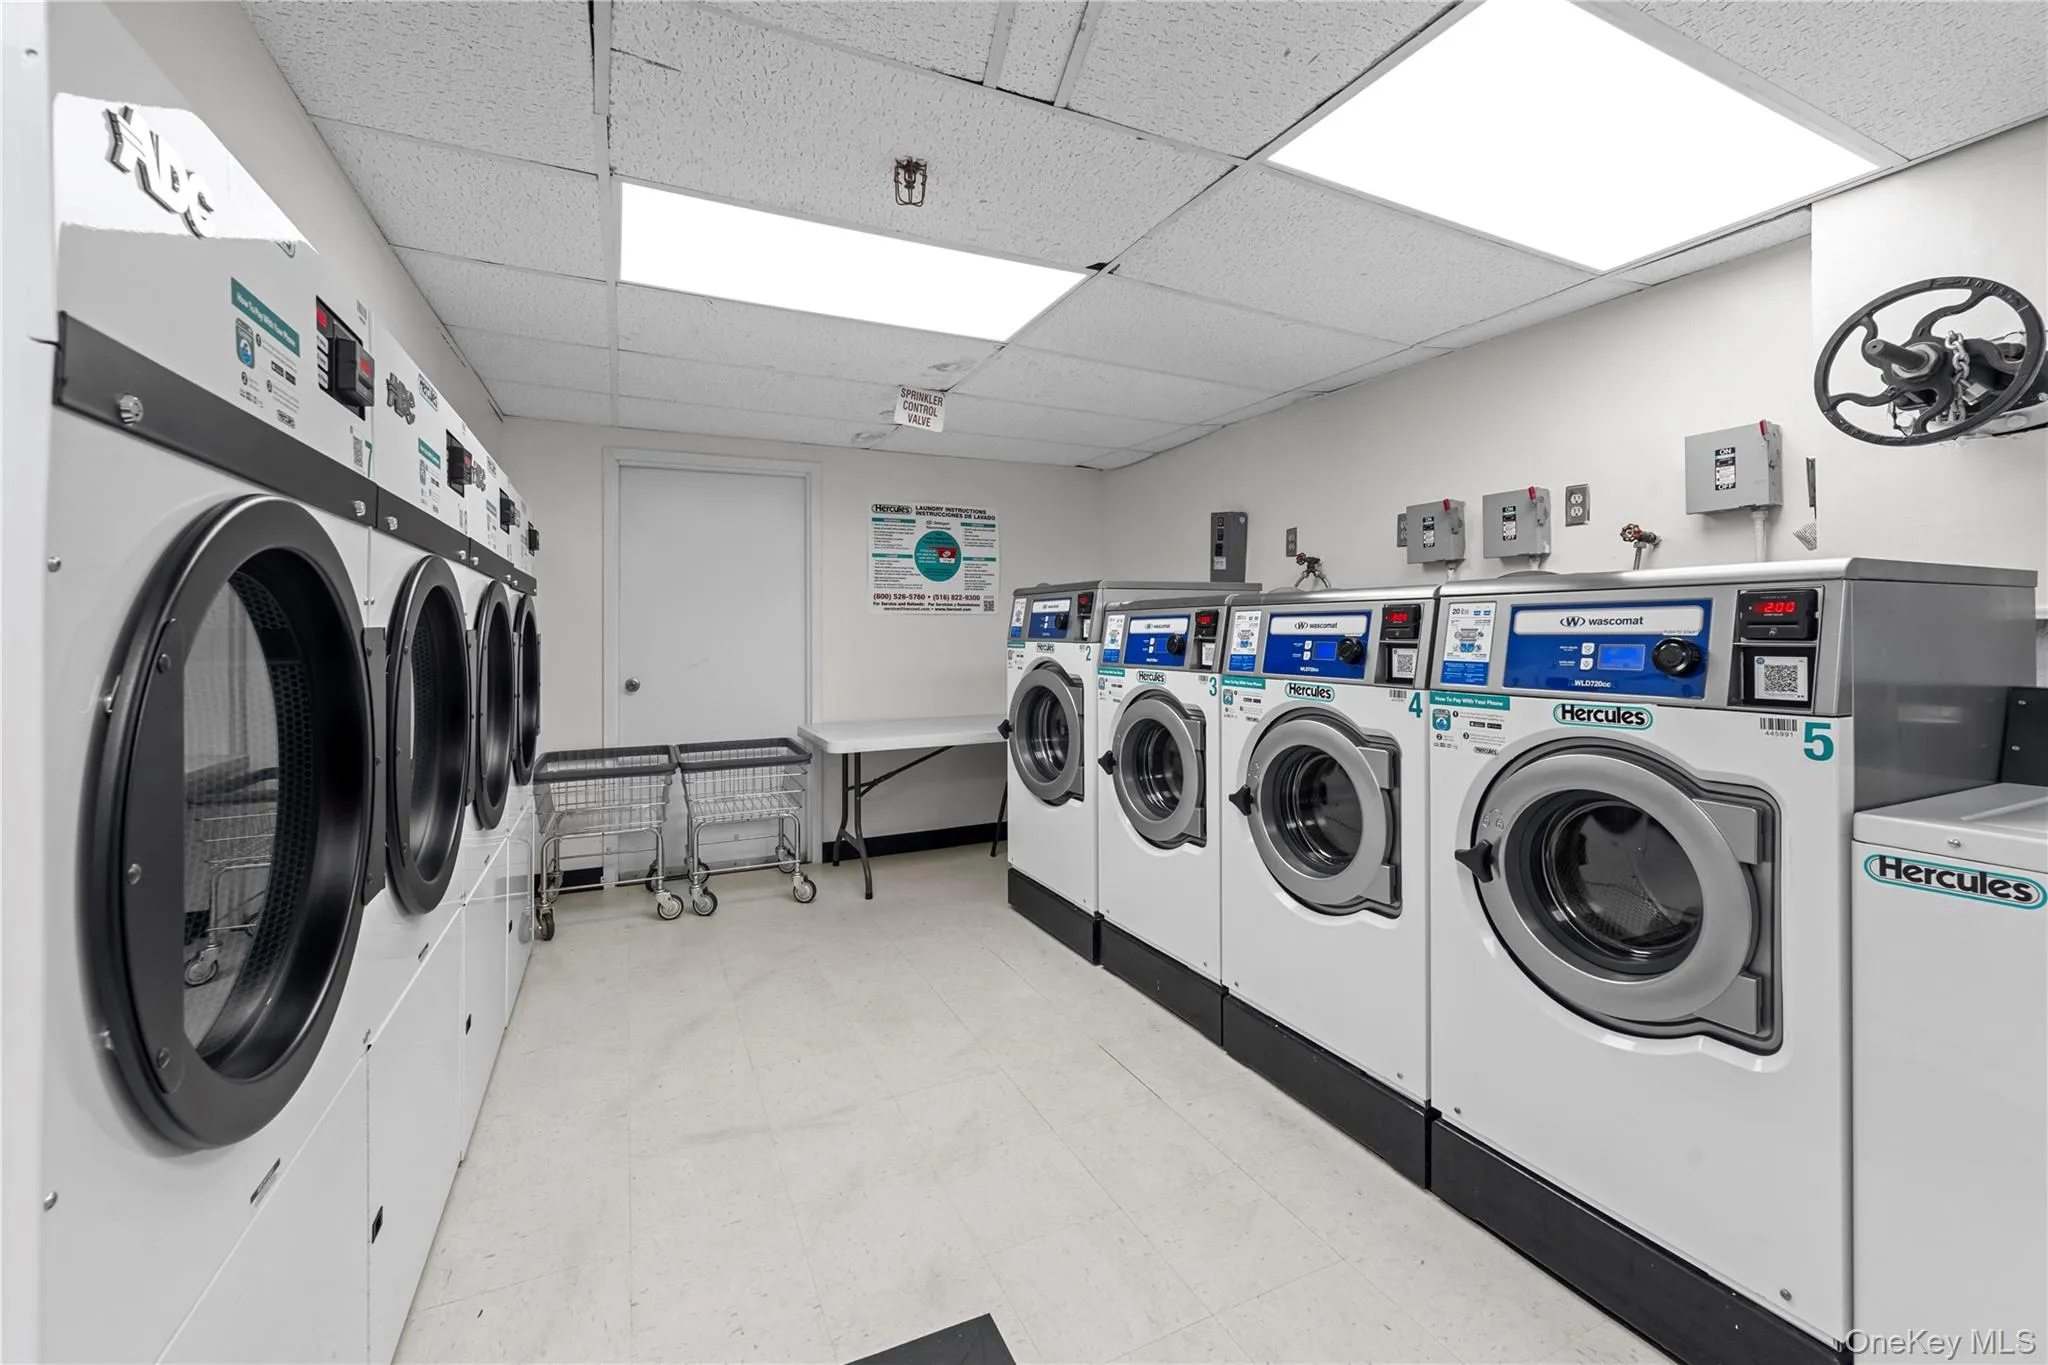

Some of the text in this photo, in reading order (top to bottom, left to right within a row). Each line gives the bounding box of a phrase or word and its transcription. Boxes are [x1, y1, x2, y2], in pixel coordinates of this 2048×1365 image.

[901, 388, 943, 406] SPRINKLER
[903, 400, 938, 418] CONTROL
[908, 414, 931, 427] VALVE
[876, 504, 910, 514] Hercules
[1588, 616, 1644, 626] wascomat
[1086, 646, 1091, 661] 2
[1138, 670, 1164, 682] Hercules
[1210, 677, 1217, 696] 3
[1289, 682, 1331, 699] Hercules
[1408, 692, 1422, 718] 4
[1561, 704, 1646, 726] Hercules
[1803, 722, 1834, 762] 5
[1879, 855, 2032, 902] Hercules
